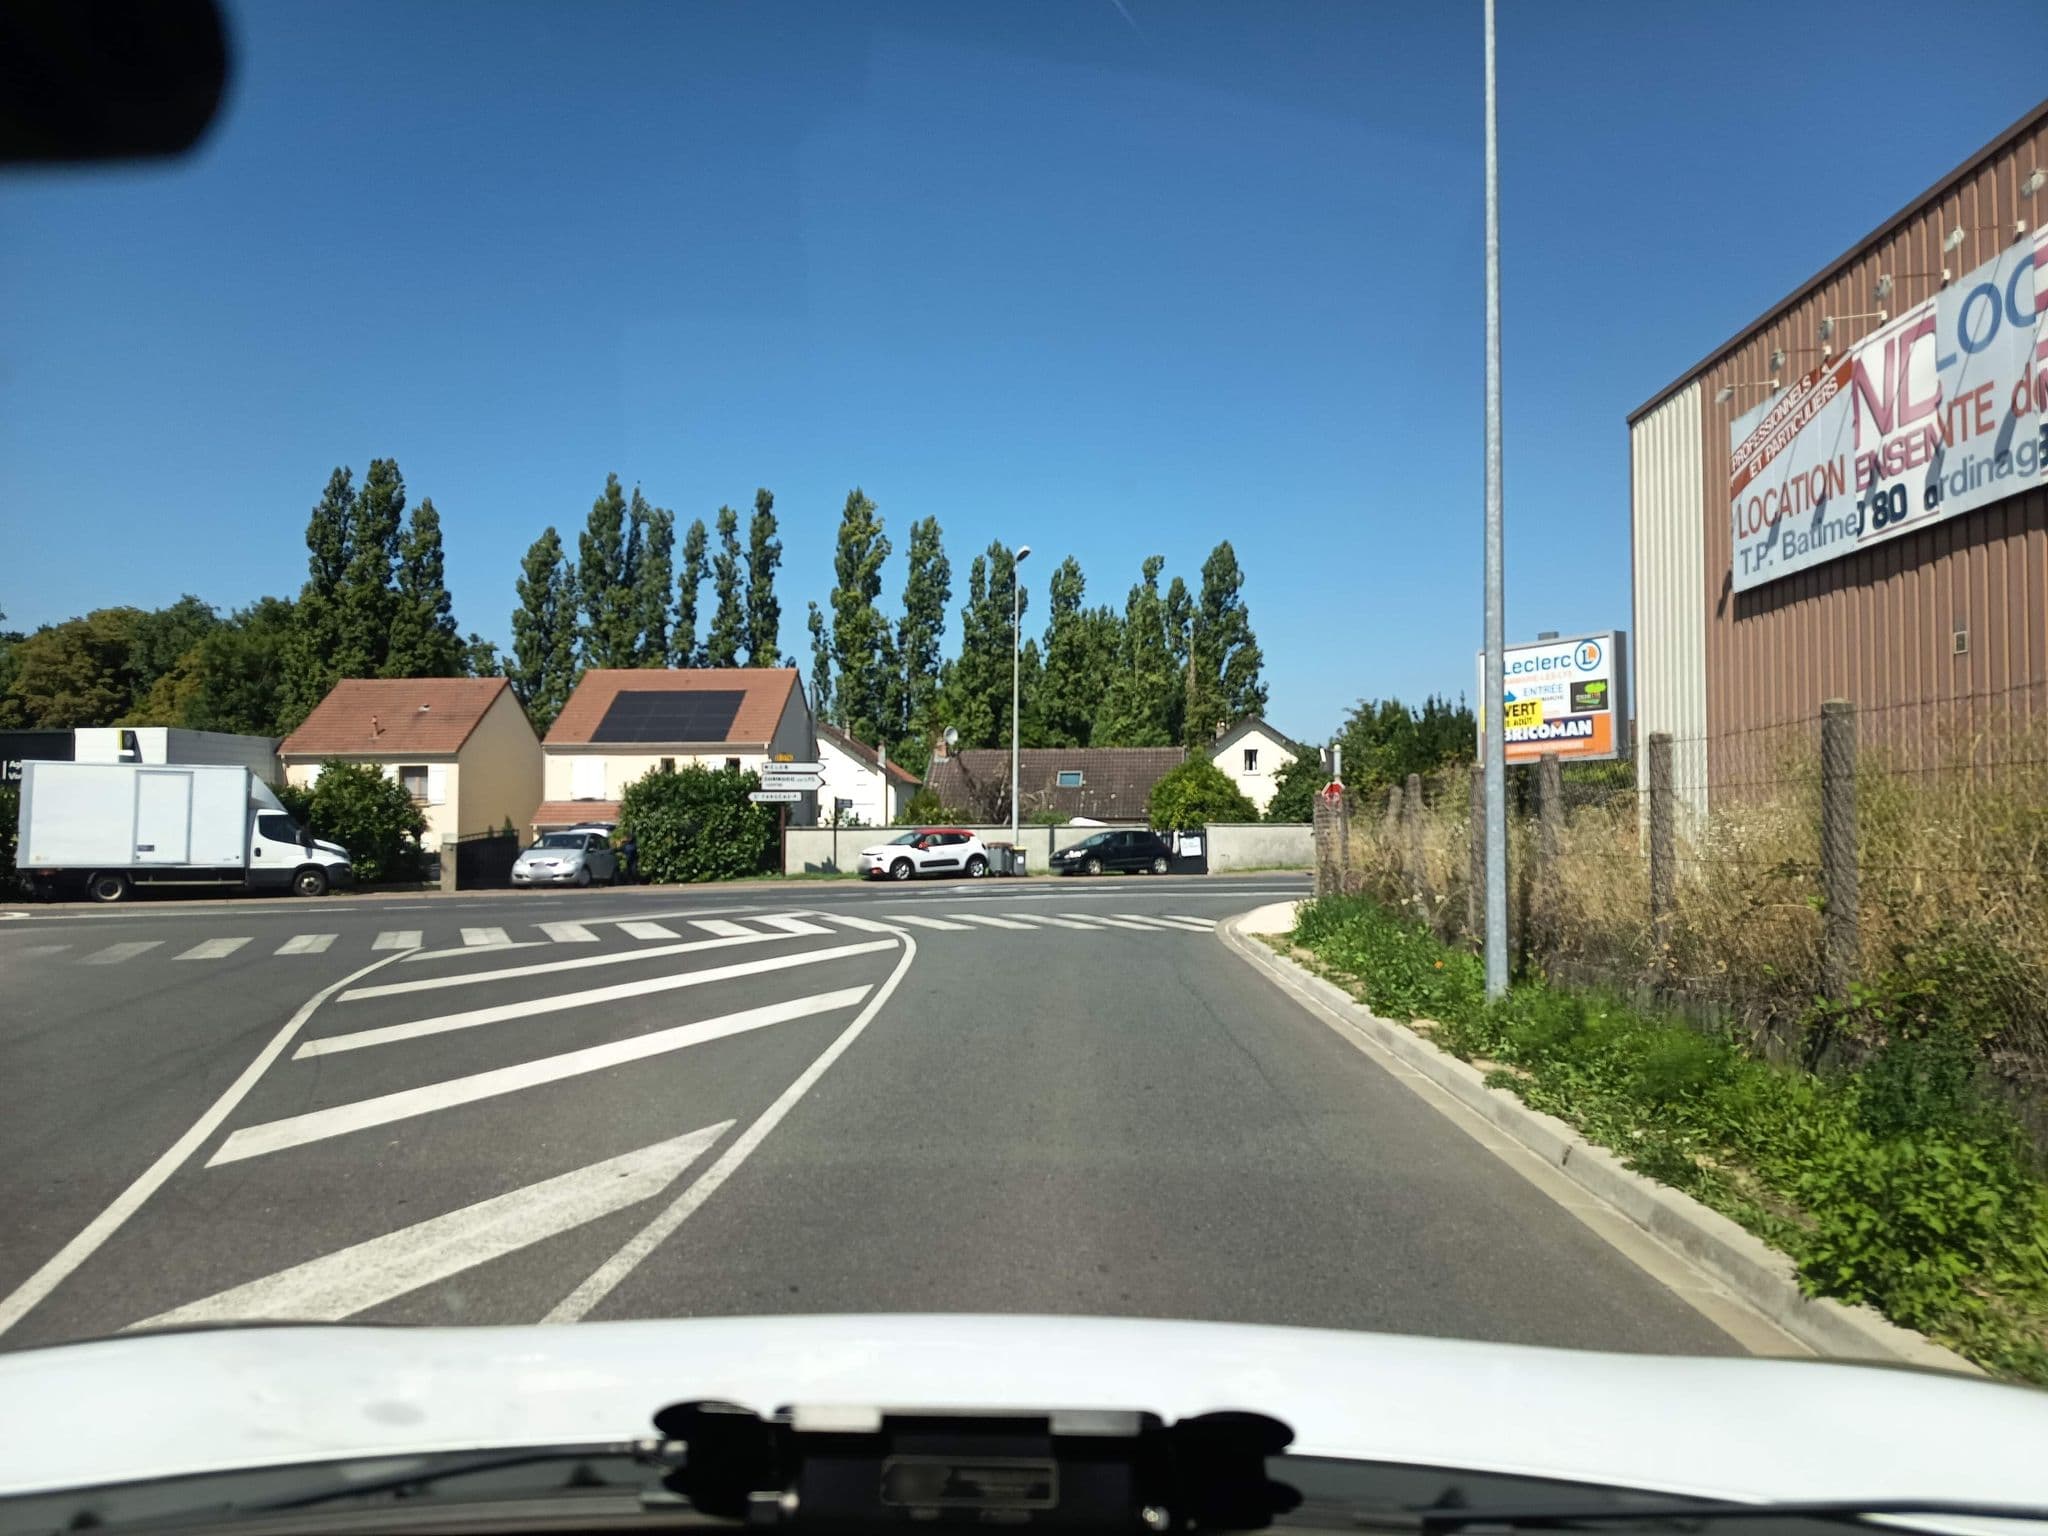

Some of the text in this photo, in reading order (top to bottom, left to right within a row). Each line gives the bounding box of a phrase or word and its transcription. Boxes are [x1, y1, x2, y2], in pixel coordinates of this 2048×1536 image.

[1732, 375, 1812, 472] PROFESSIONNELS
[1750, 376, 1838, 478] ET PARTICULIERS
[1738, 454, 1845, 539] LOCATION
